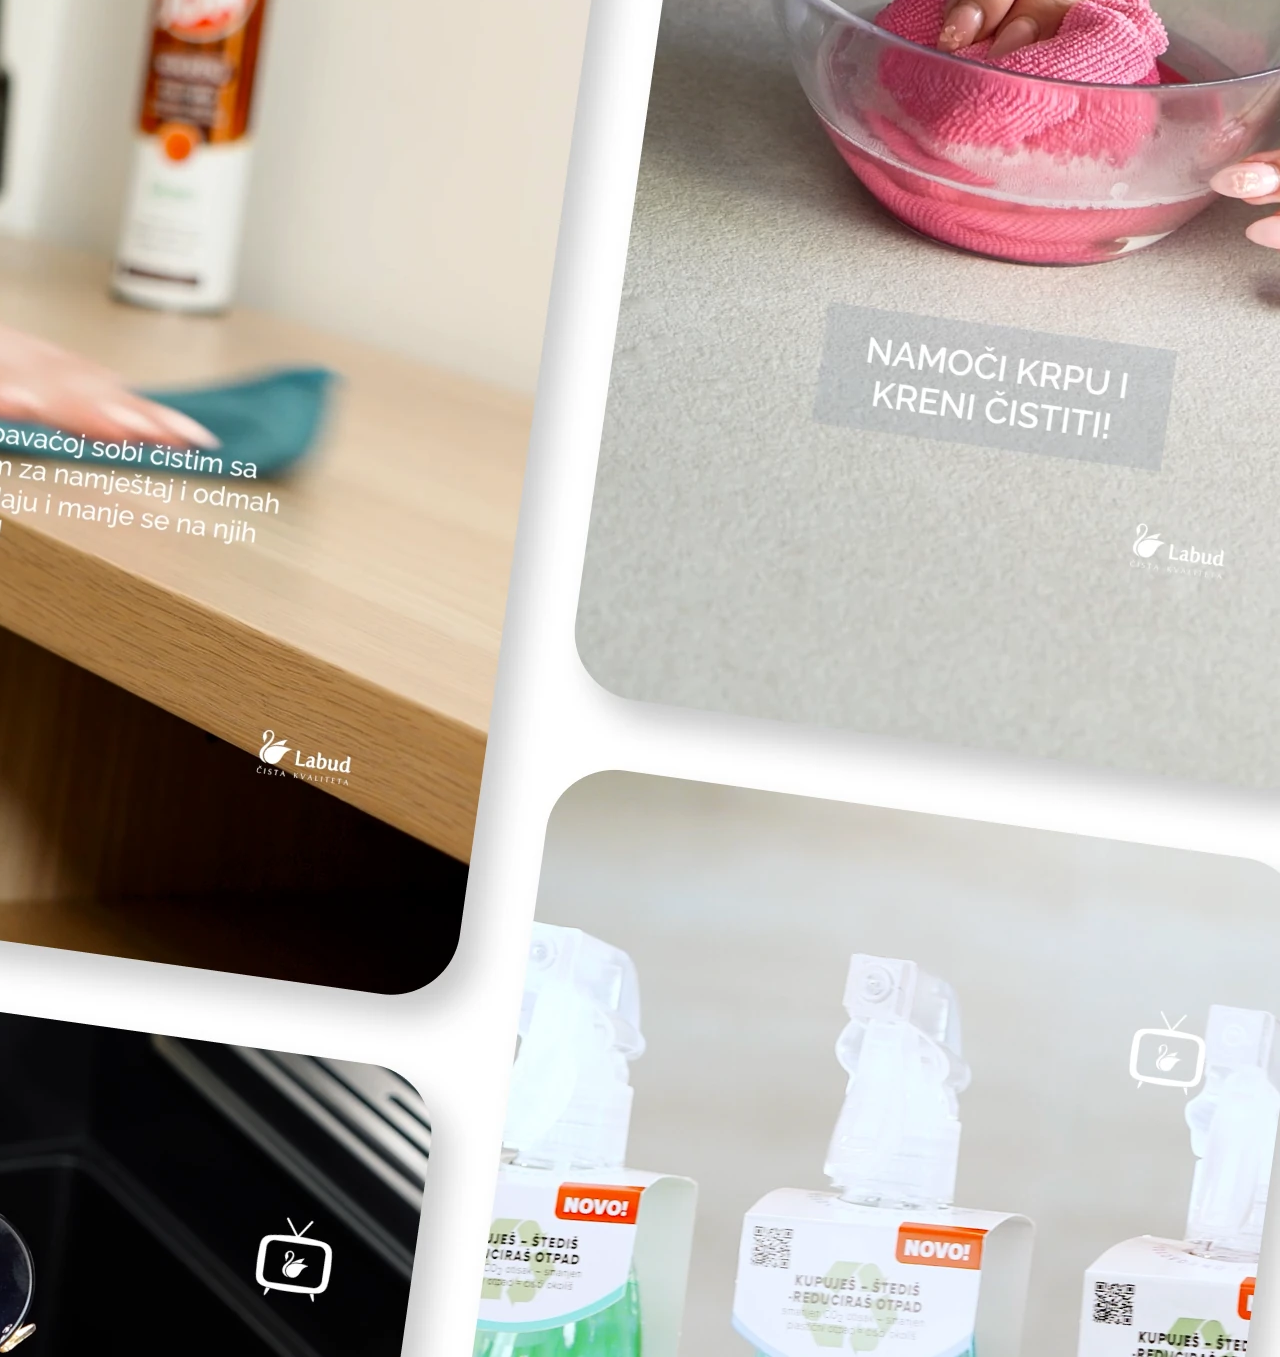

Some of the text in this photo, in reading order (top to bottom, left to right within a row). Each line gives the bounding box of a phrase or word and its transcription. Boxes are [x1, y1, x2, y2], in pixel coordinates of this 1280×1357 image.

[563, 1196, 629, 1217] NOVO!
[532, 1234, 579, 1250] ŠTEDIŠ
[904, 1239, 971, 1261] NOVO!
[535, 1251, 580, 1265] OTPAD
[794, 1273, 920, 1297] KUPUJEŠ ŠTEDIŠ
[876, 1297, 923, 1313] OTPAD
[1138, 1330, 1199, 1348] KUPUJEŠ
